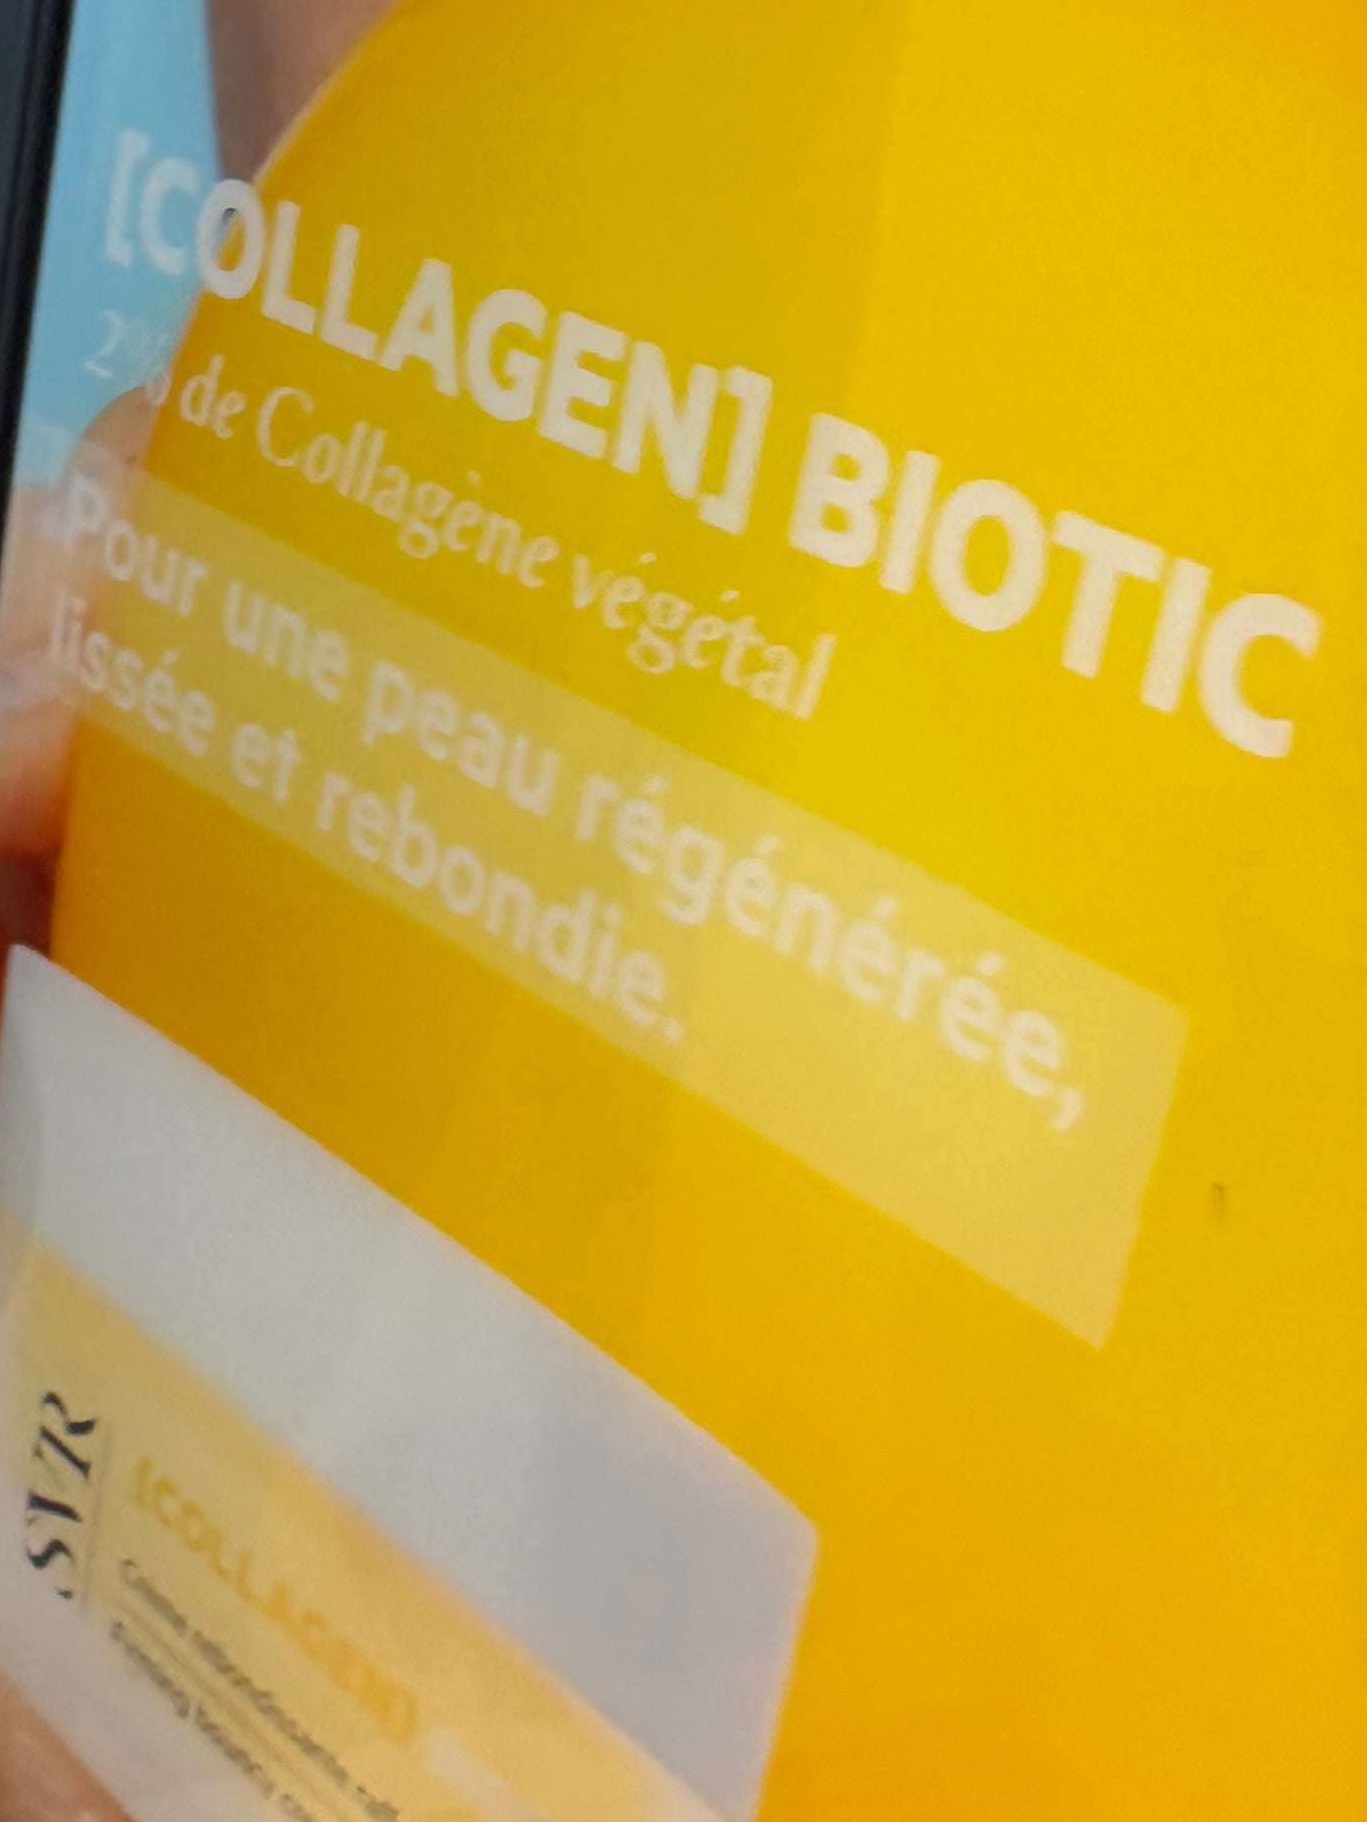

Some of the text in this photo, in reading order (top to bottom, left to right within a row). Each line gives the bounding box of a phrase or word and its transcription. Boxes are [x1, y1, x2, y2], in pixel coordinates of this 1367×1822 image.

[103, 129, 1323, 759] [COLLAGEN] BIOTIC
[178, 353, 248, 441] de
[255, 385, 560, 590] Collagène
[571, 551, 839, 721] végétal
[47, 590, 684, 1046] lissée et rebondie.
[66, 472, 1087, 1132] Pour une peau régénérée,
